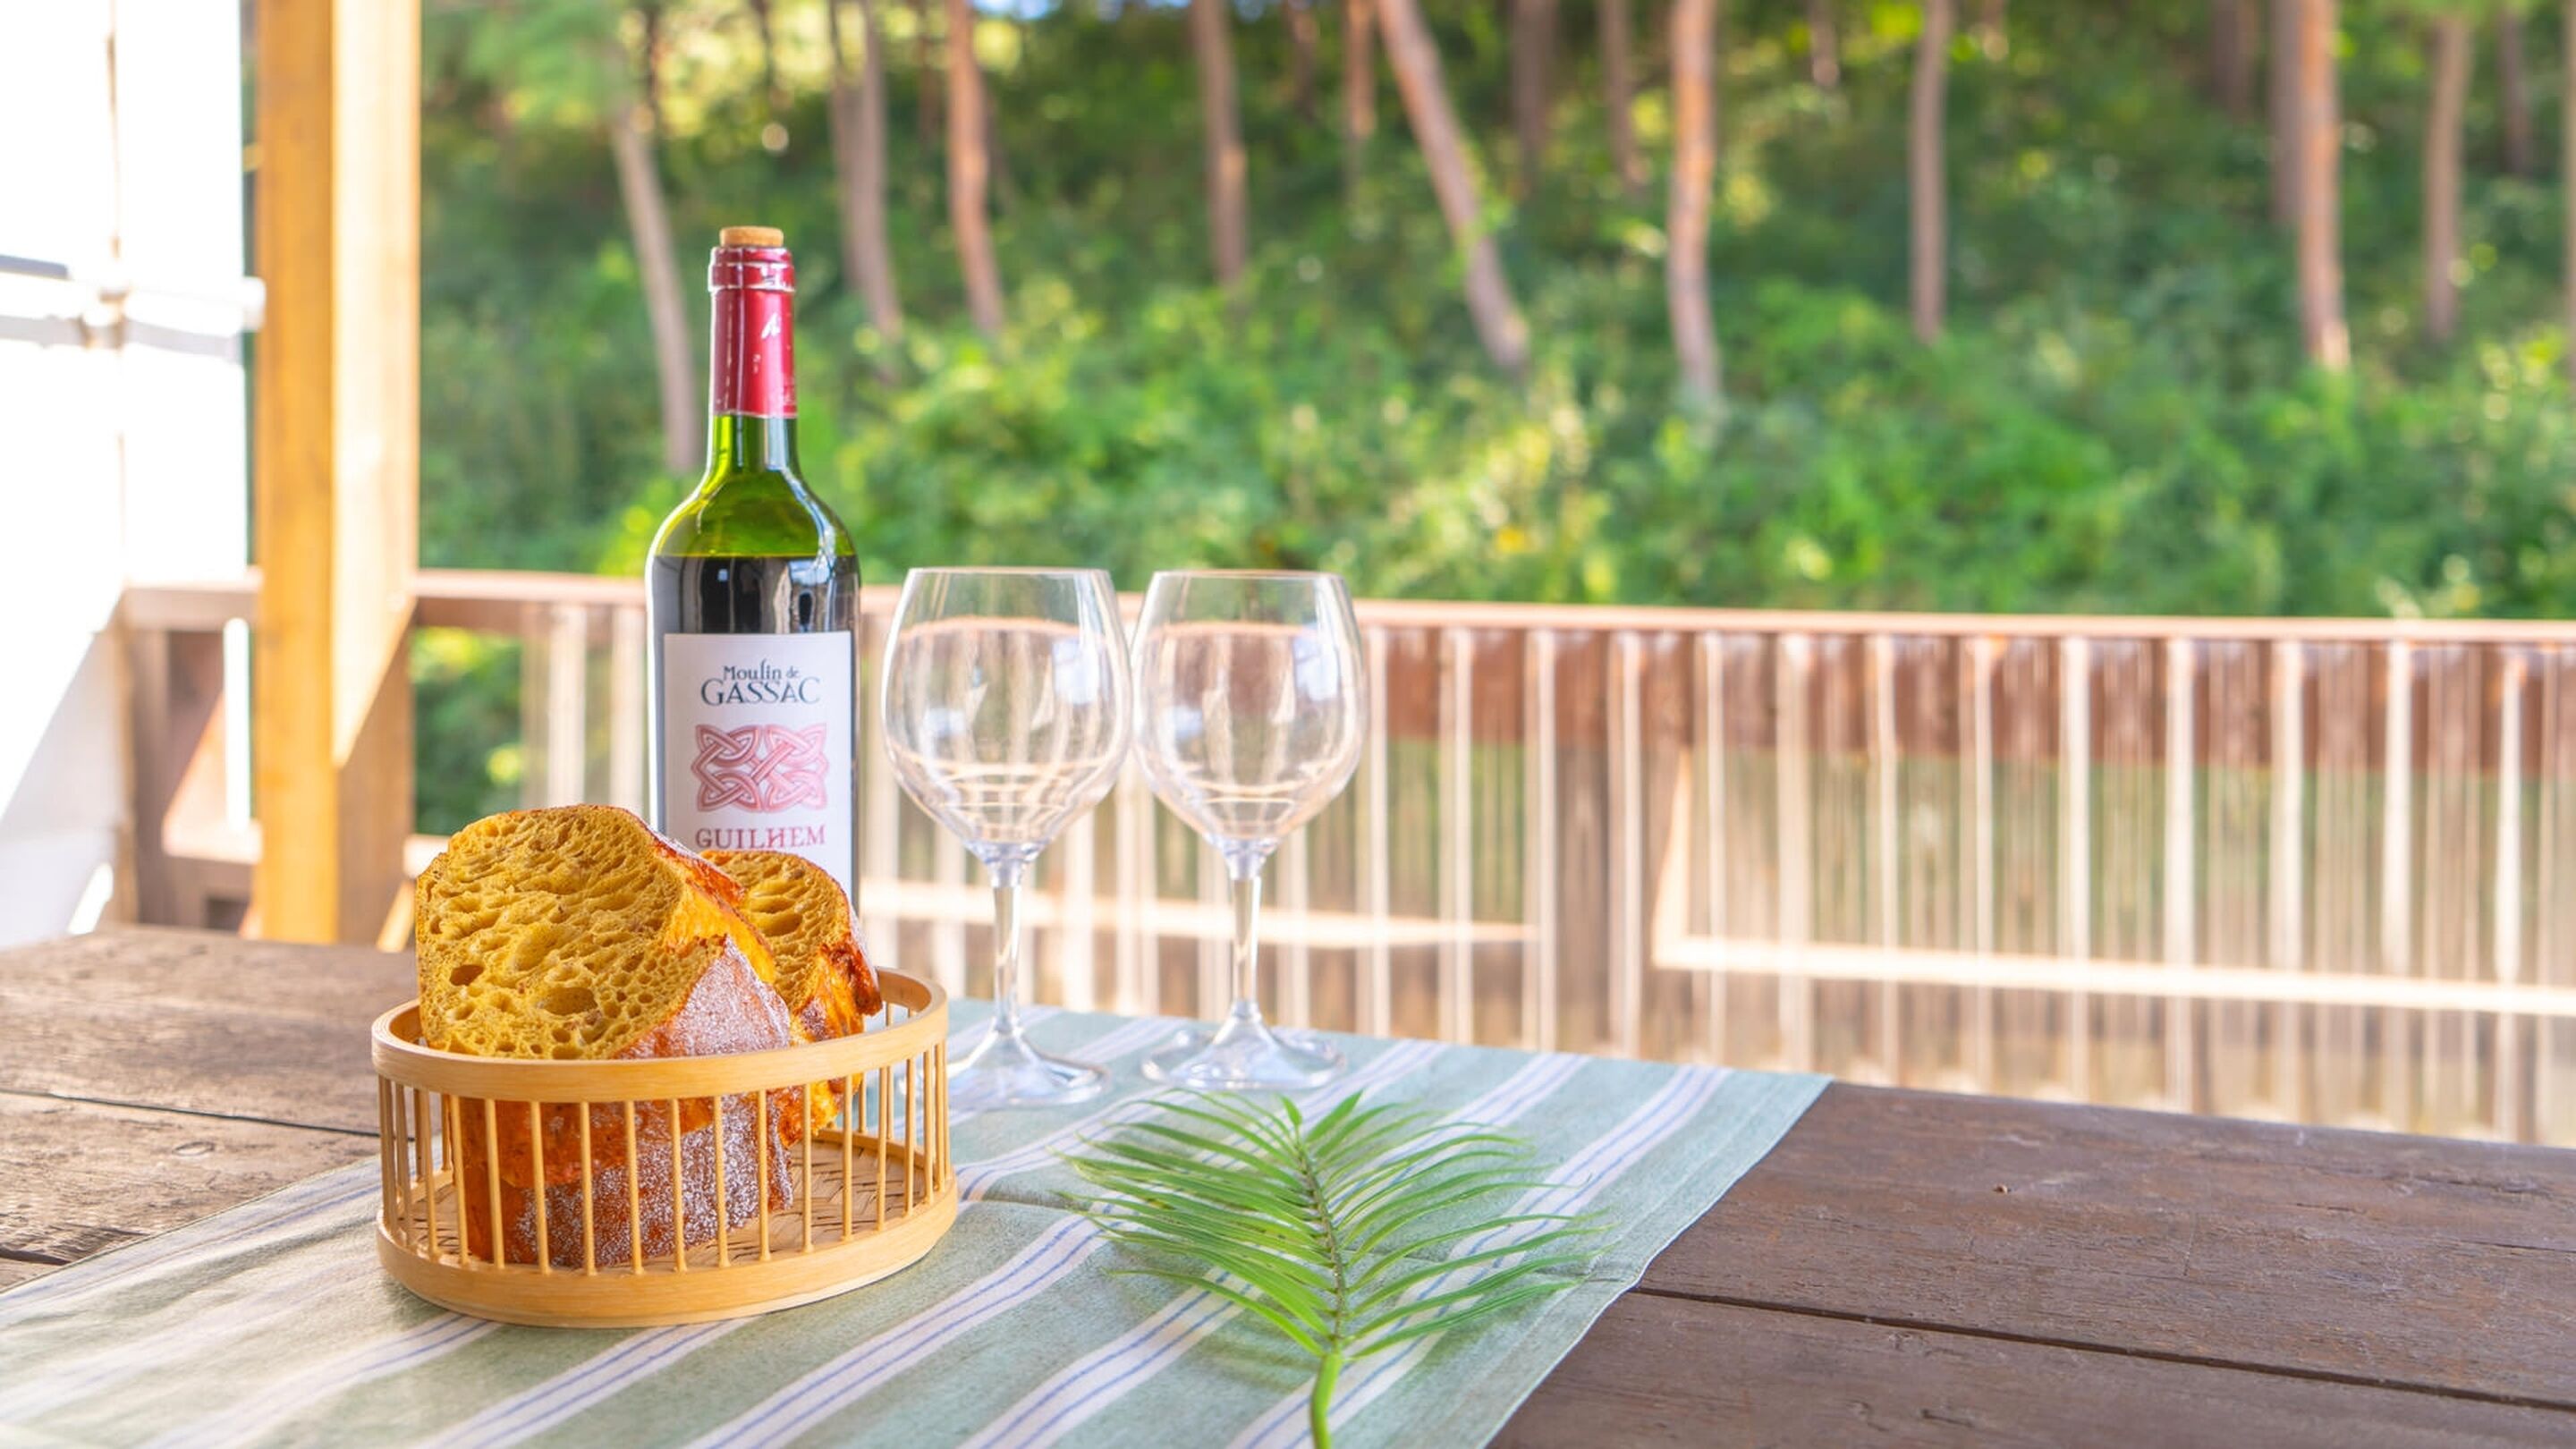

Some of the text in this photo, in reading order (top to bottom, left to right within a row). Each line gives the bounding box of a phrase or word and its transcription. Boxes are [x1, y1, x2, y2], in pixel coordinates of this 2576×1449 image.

[723, 658, 800, 680] Moulin de
[701, 676, 821, 706] GASSAC
[696, 826, 826, 849] GUILHEM
